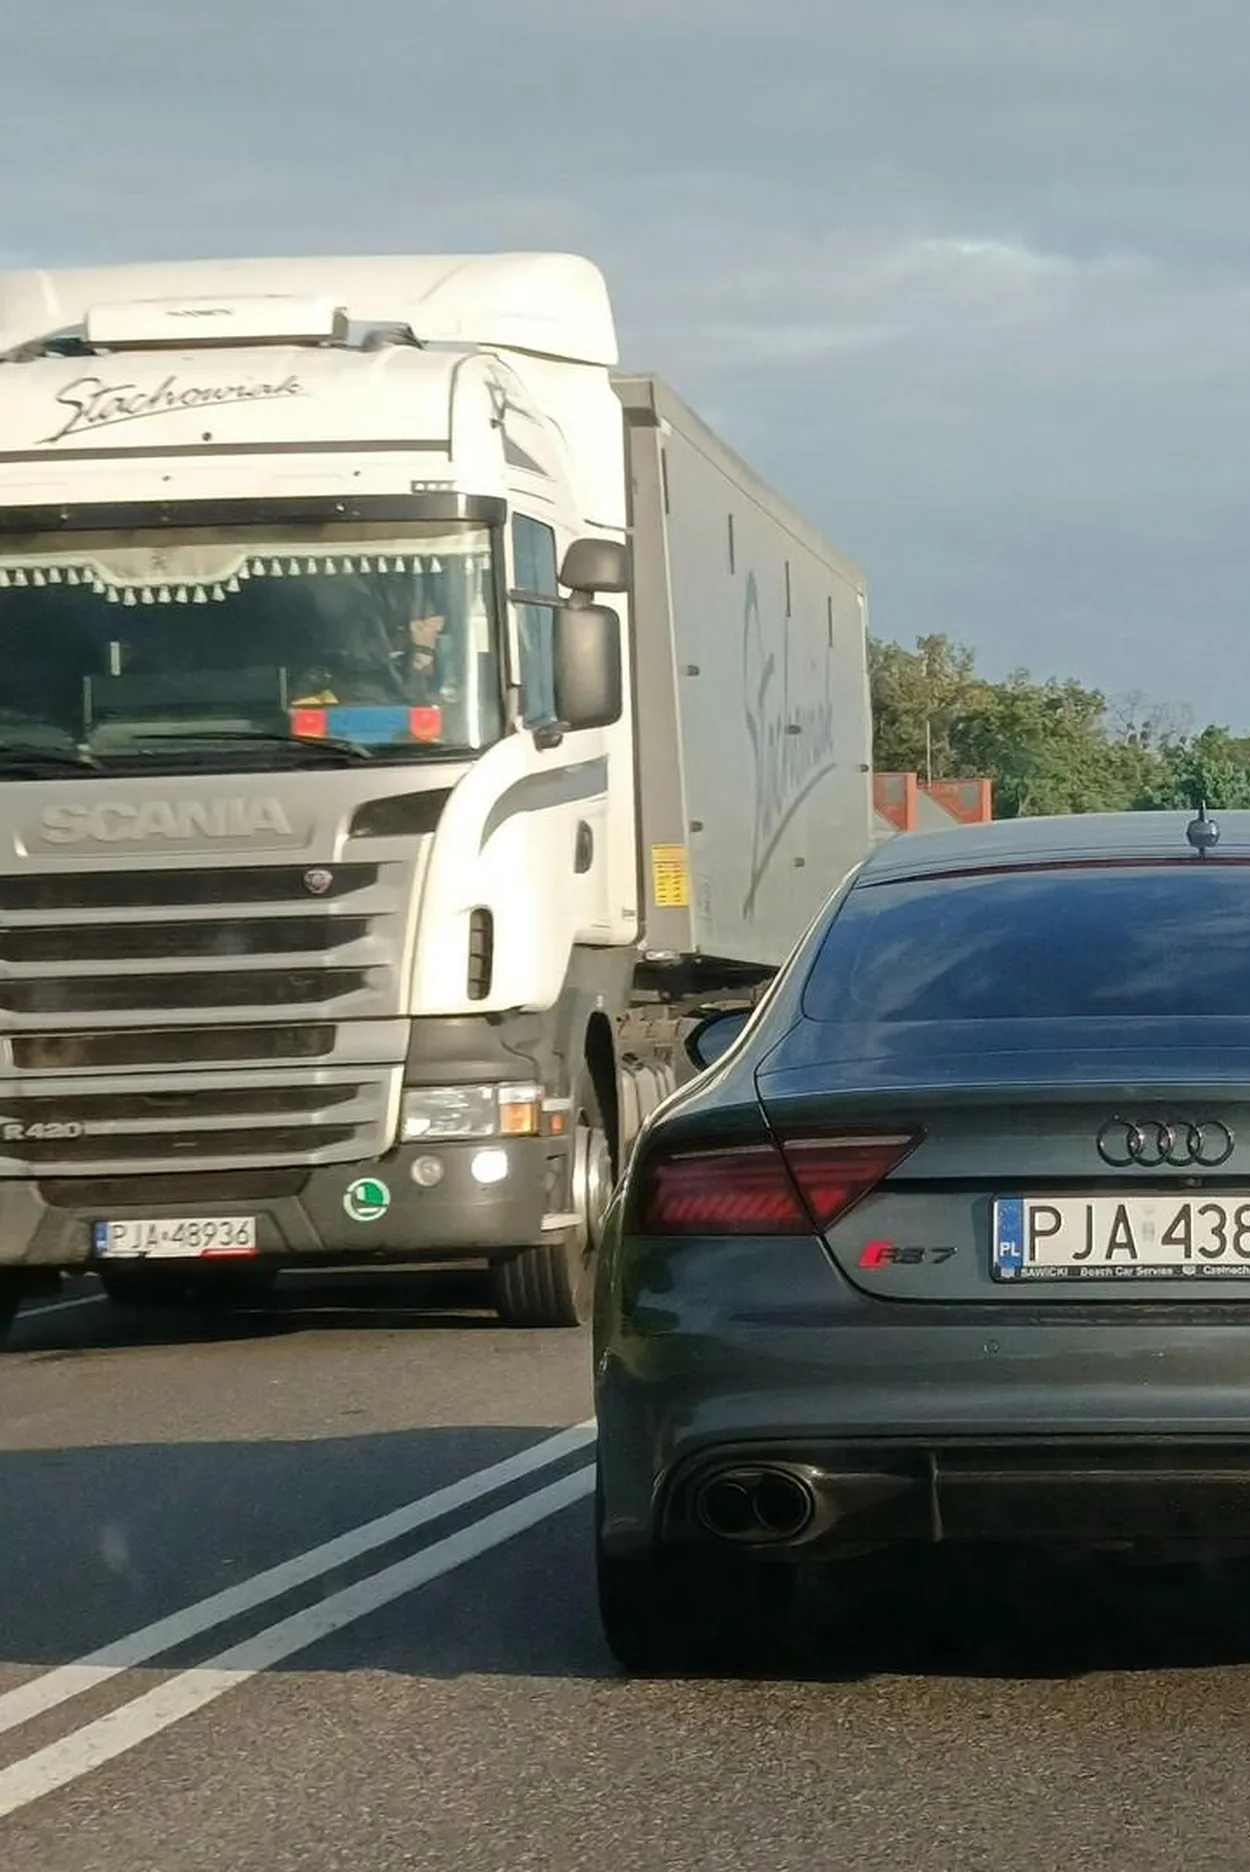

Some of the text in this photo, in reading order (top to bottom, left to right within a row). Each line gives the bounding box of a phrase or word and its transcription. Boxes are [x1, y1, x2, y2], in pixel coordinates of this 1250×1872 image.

[41, 797, 292, 845] SCANIA
[111, 1220, 250, 1250] PJA 48936
[1028, 1203, 1138, 1262] PJA
[1000, 1241, 1020, 1257] PL
[1020, 1267, 1069, 1277] SAWICKI
[1115, 1266, 1133, 1277] Car
